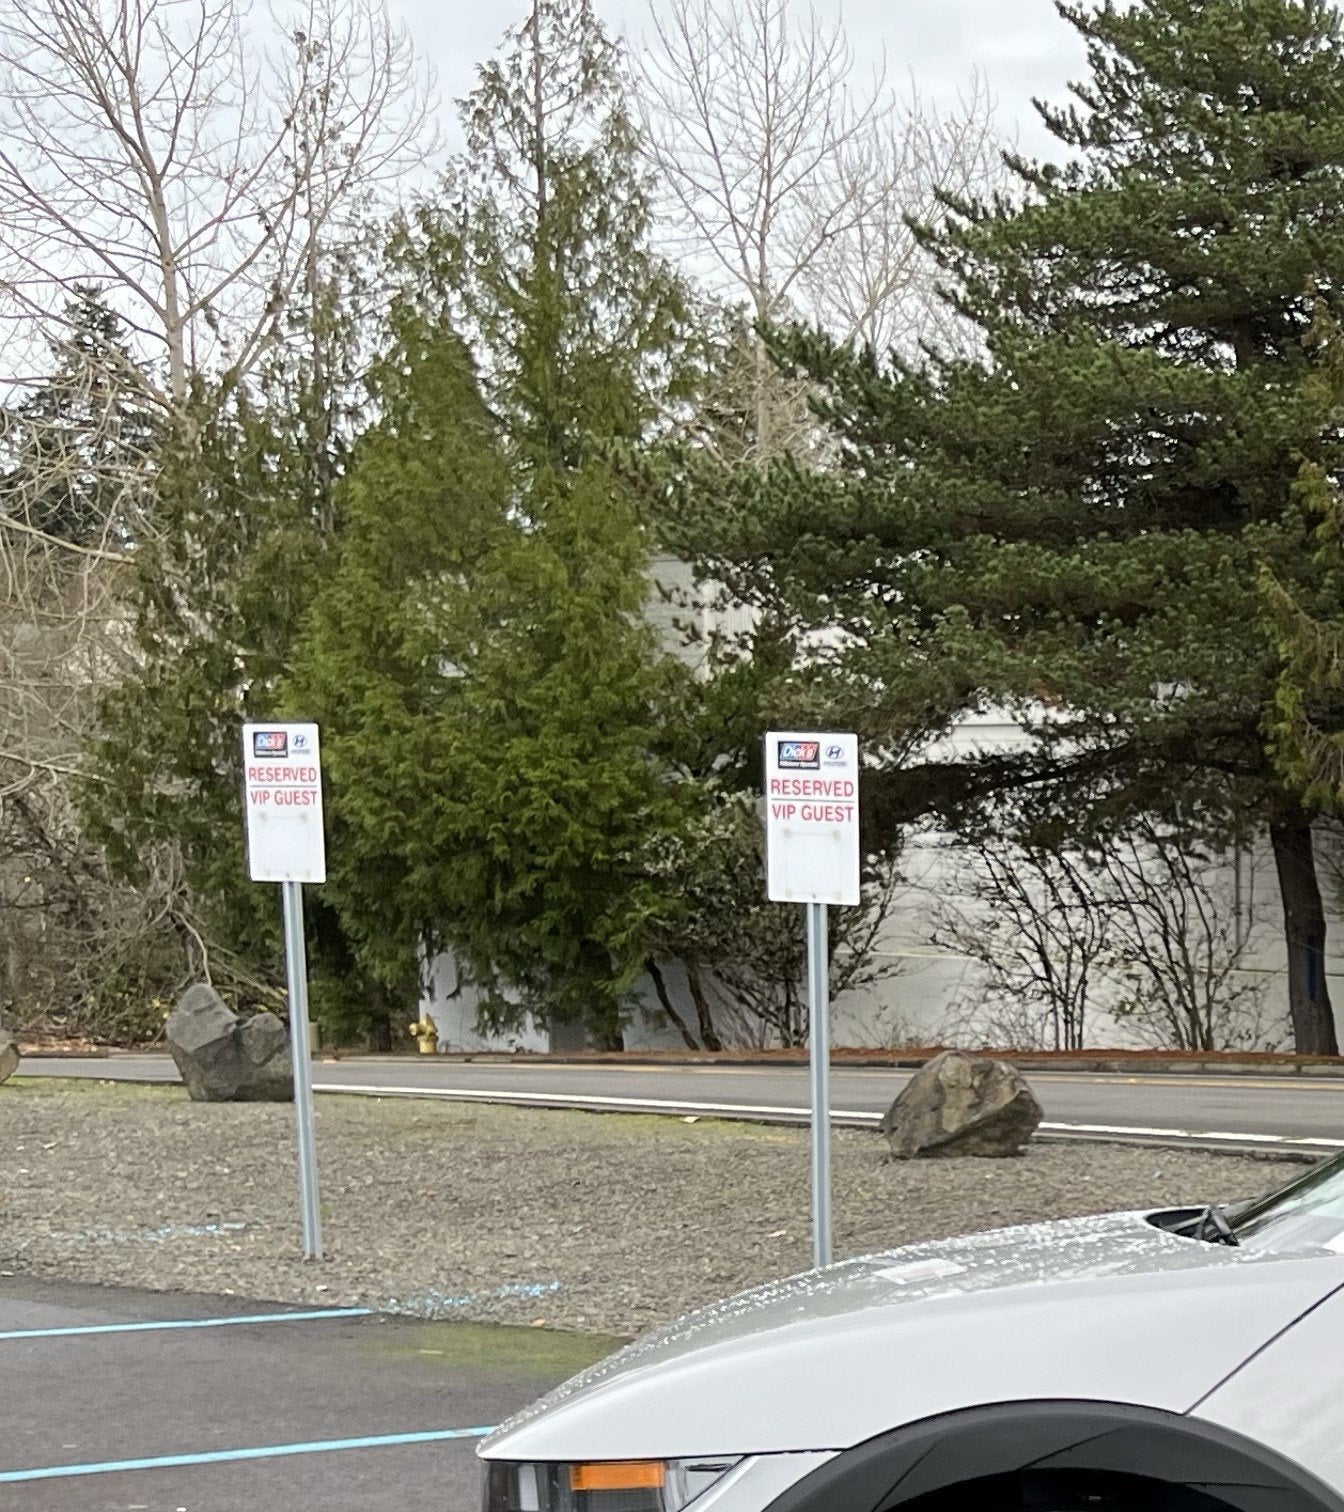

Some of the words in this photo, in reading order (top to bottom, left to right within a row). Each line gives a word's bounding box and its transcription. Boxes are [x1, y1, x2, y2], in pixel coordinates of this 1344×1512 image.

[248, 766, 317, 782] RESERVED
[770, 779, 854, 796] RESERVED
[250, 789, 271, 805] VIP
[274, 790, 318, 806] GUEST
[772, 804, 796, 820] VIP
[801, 805, 855, 823] GUEST
